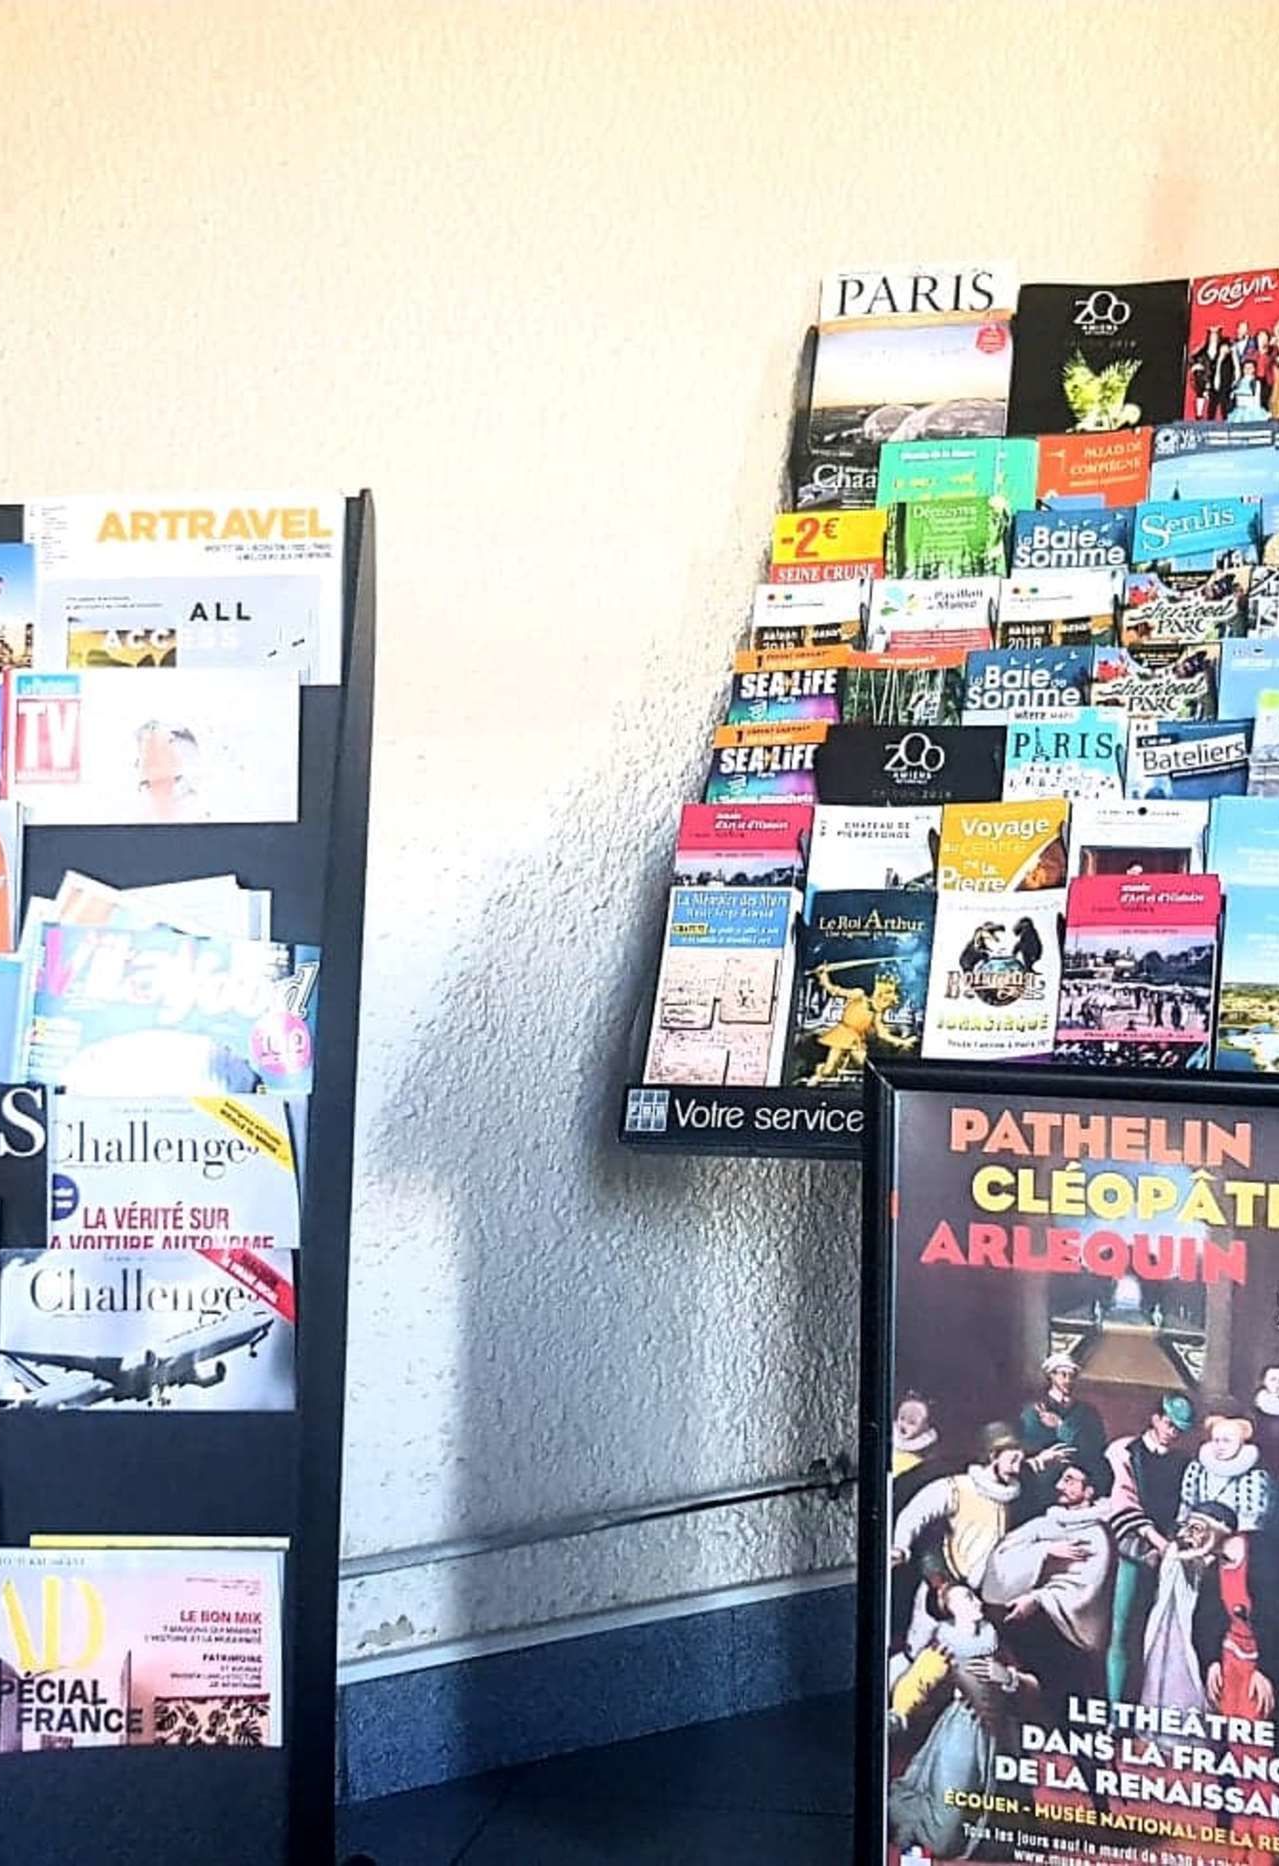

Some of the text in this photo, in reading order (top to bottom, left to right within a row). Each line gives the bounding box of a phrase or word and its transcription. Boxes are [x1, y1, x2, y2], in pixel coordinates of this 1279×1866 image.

[836, 271, 996, 316] PARIS
[1197, 275, 1277, 309] Grévin
[814, 464, 877, 494] Chaa
[96, 508, 334, 544] ARTRAVEL
[1034, 525, 1097, 548] Baie
[1141, 507, 1235, 551] Senlis
[1016, 546, 1126, 568] Somme
[189, 602, 252, 622] ALL
[740, 672, 785, 699] SEA
[984, 666, 1052, 690] Baie
[966, 684, 1080, 709] Somme
[18, 702, 81, 770] TV
[1013, 729, 1114, 760] PARIS
[720, 746, 763, 774] SEA
[1143, 741, 1245, 772] Bateliers
[961, 817, 1050, 840] Voyage
[819, 908, 926, 931] Le Roi Arthur
[675, 1098, 865, 1133] Votre service
[949, 1107, 1254, 1170] PATHELIN
[83, 1201, 230, 1231] LA VÉRITÉ SUR
[69, 1235, 153, 1250] VOITURE
[919, 1220, 1248, 1287] ARLEQUIN
[179, 1609, 199, 1624] LE
[234, 1610, 262, 1625] MIX
[16, 1707, 144, 1735] FRANCE
[1068, 1696, 1275, 1747] LE THÉÂTRE
[1022, 1724, 1116, 1762] DANS
[1122, 1737, 1167, 1769] LA
[994, 1754, 1039, 1786] DE
[1045, 1760, 1090, 1792] LA
[944, 1788, 1020, 1814] ÉCOUEN
[1034, 1802, 1097, 1826] MUSÉE
[1099, 1812, 1197, 1840] NATIONAL
[1200, 1826, 1228, 1844] DE
[1229, 1830, 1255, 1849] LA
[995, 1826, 1014, 1843] les
[1016, 1828, 1050, 1850] jours
[1099, 1845, 1138, 1859] mardi
[1141, 1849, 1157, 1862] de
